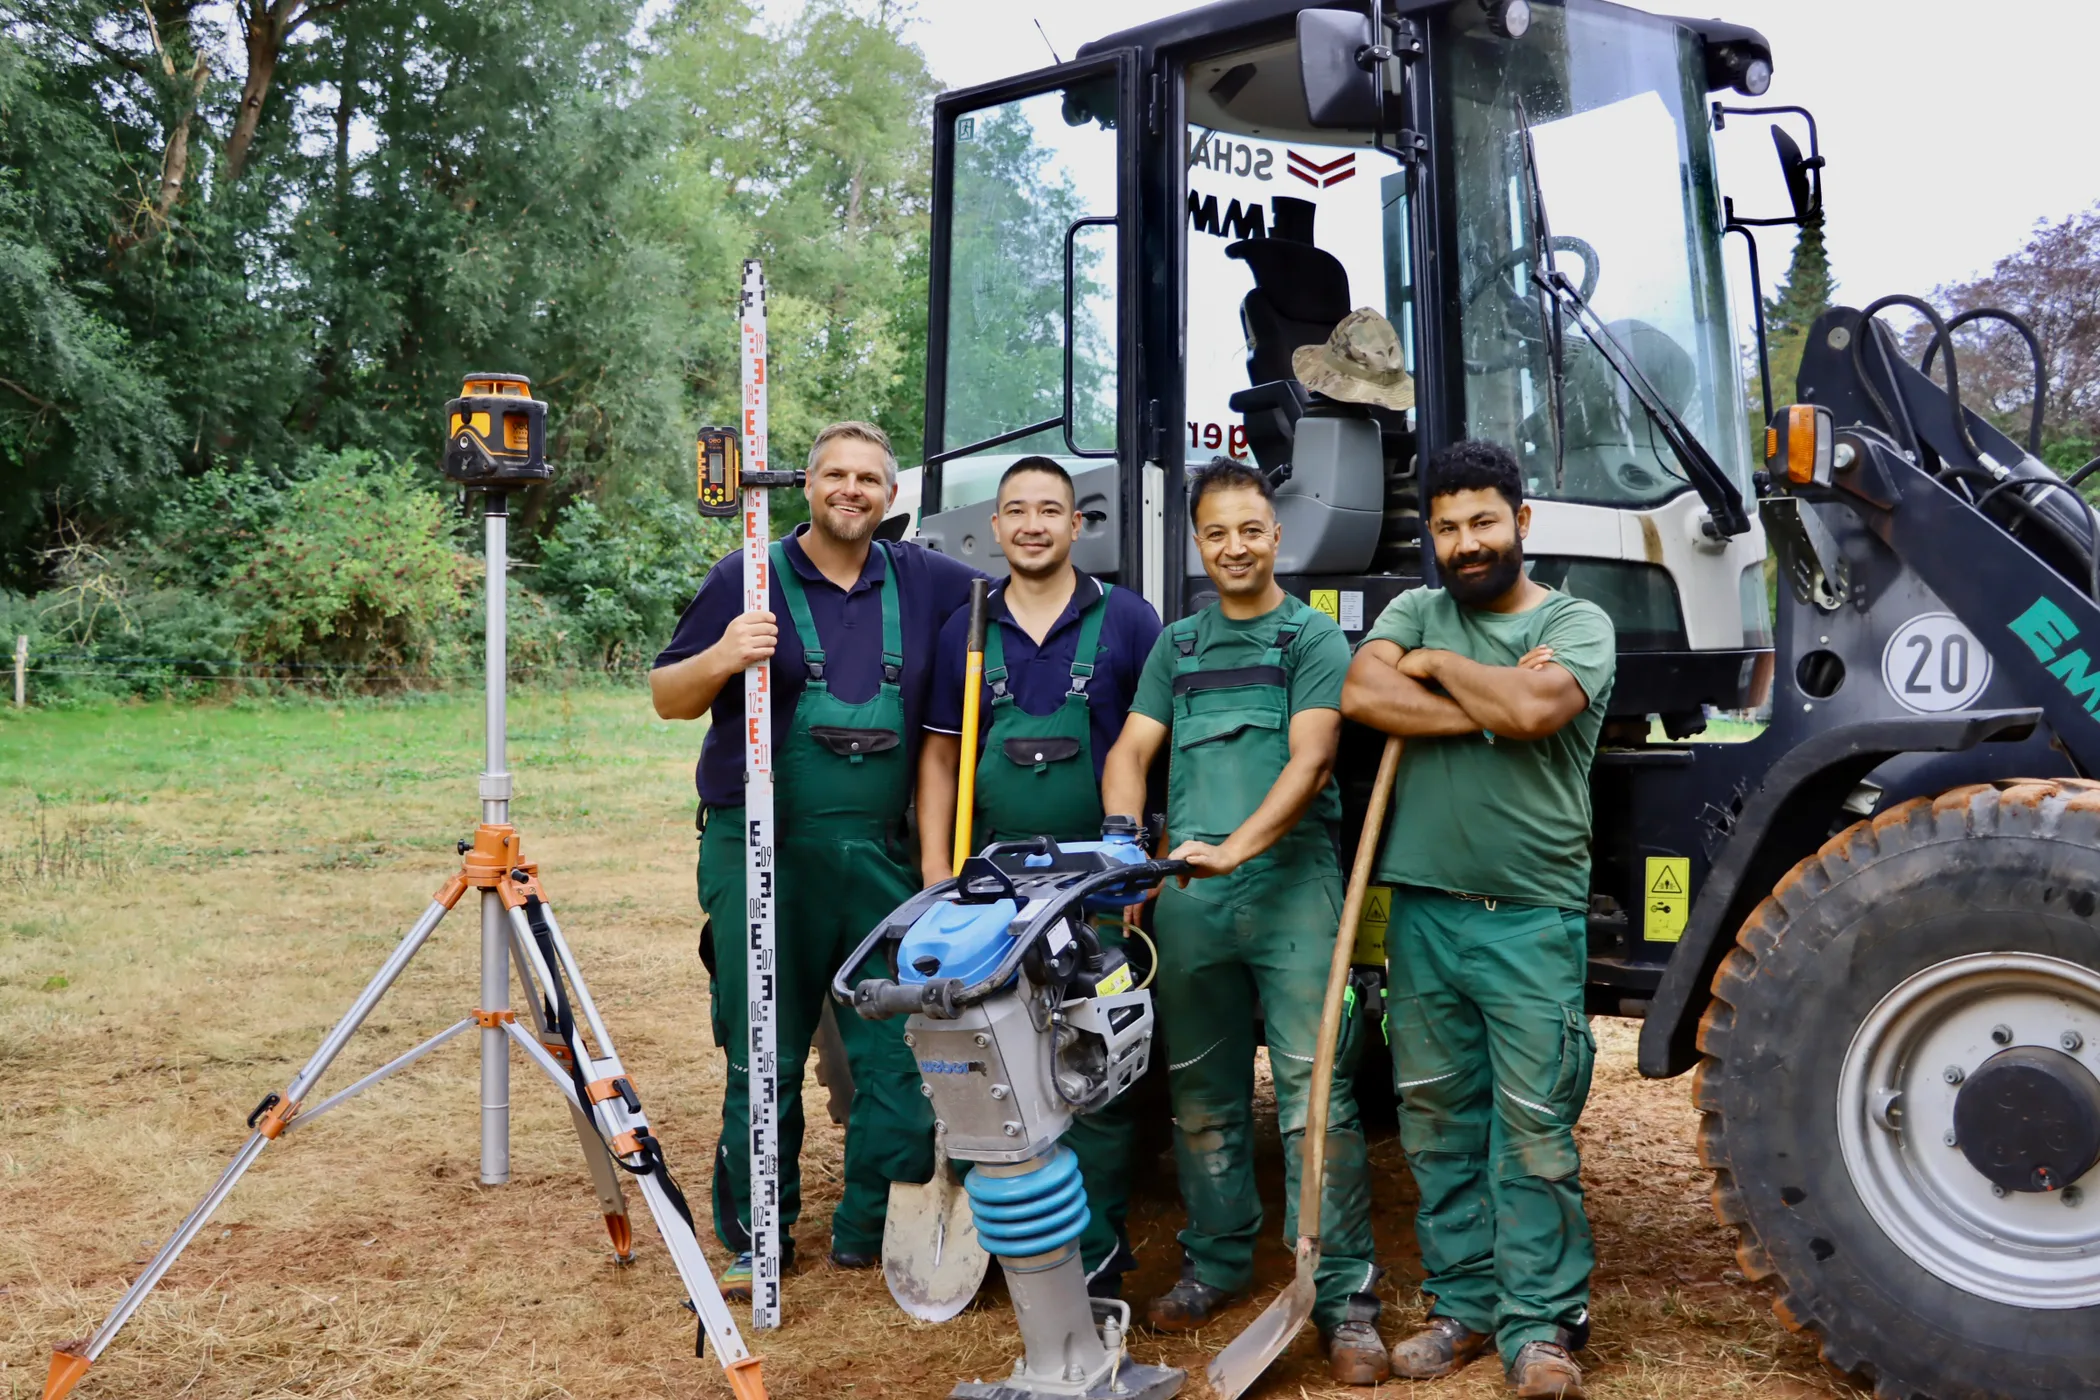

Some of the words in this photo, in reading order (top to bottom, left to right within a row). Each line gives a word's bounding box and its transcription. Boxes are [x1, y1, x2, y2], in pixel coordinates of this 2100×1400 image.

[755, 333, 764, 353] 19
[745, 384, 754, 405] 18
[756, 435, 765, 456] 17
[757, 537, 766, 559] 15
[1905, 633, 1969, 694] 20
[2006, 595, 2100, 724] EM
[748, 692, 757, 714] 12
[760, 744, 768, 765] 11
[761, 846, 772, 867] 09
[749, 897, 761, 919] 08
[762, 949, 773, 970] 07
[751, 1000, 762, 1022] 06
[763, 1051, 774, 1073] 05
[753, 1206, 764, 1227] 02
[766, 1256, 777, 1277] 01
